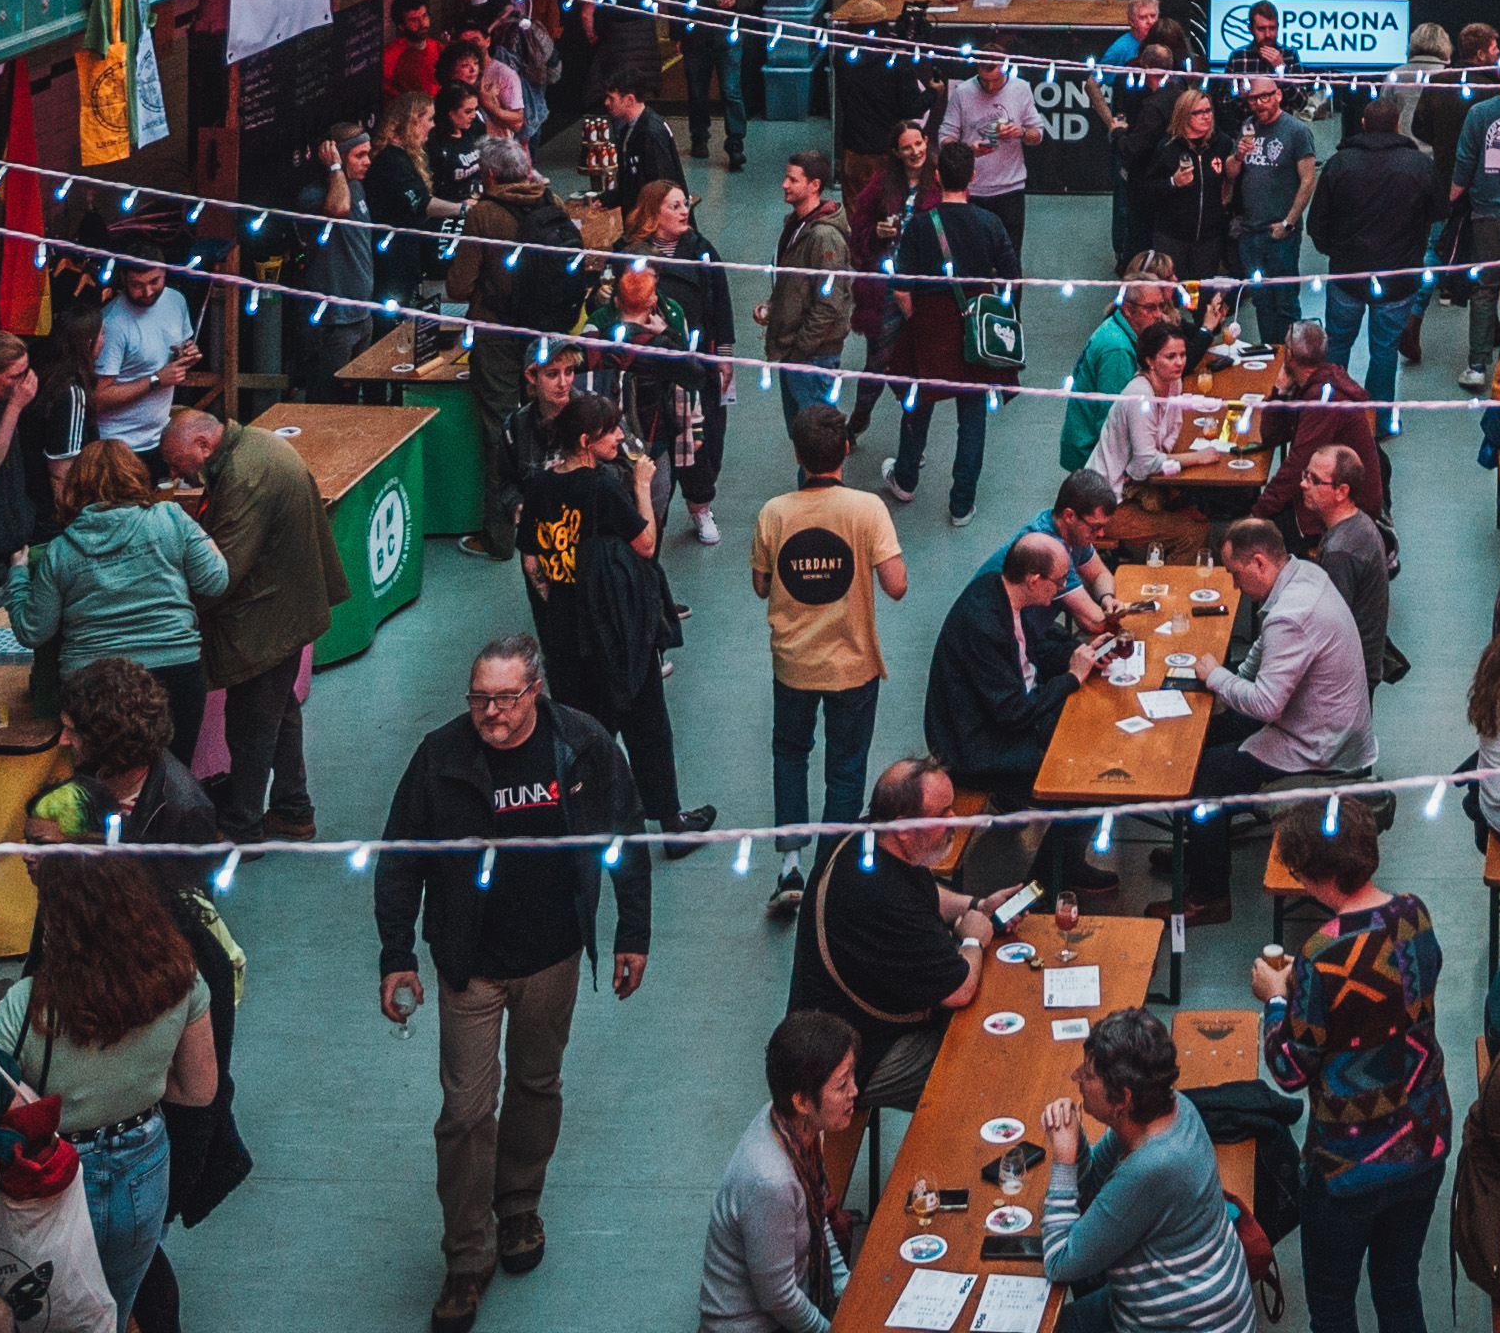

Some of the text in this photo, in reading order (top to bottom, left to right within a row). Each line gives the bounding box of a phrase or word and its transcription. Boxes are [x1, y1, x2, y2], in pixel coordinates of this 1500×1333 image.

[1284, 10, 1399, 32] POMONA
[1281, 32, 1378, 53] ISLAND
[789, 557, 843, 572] VERDANT
